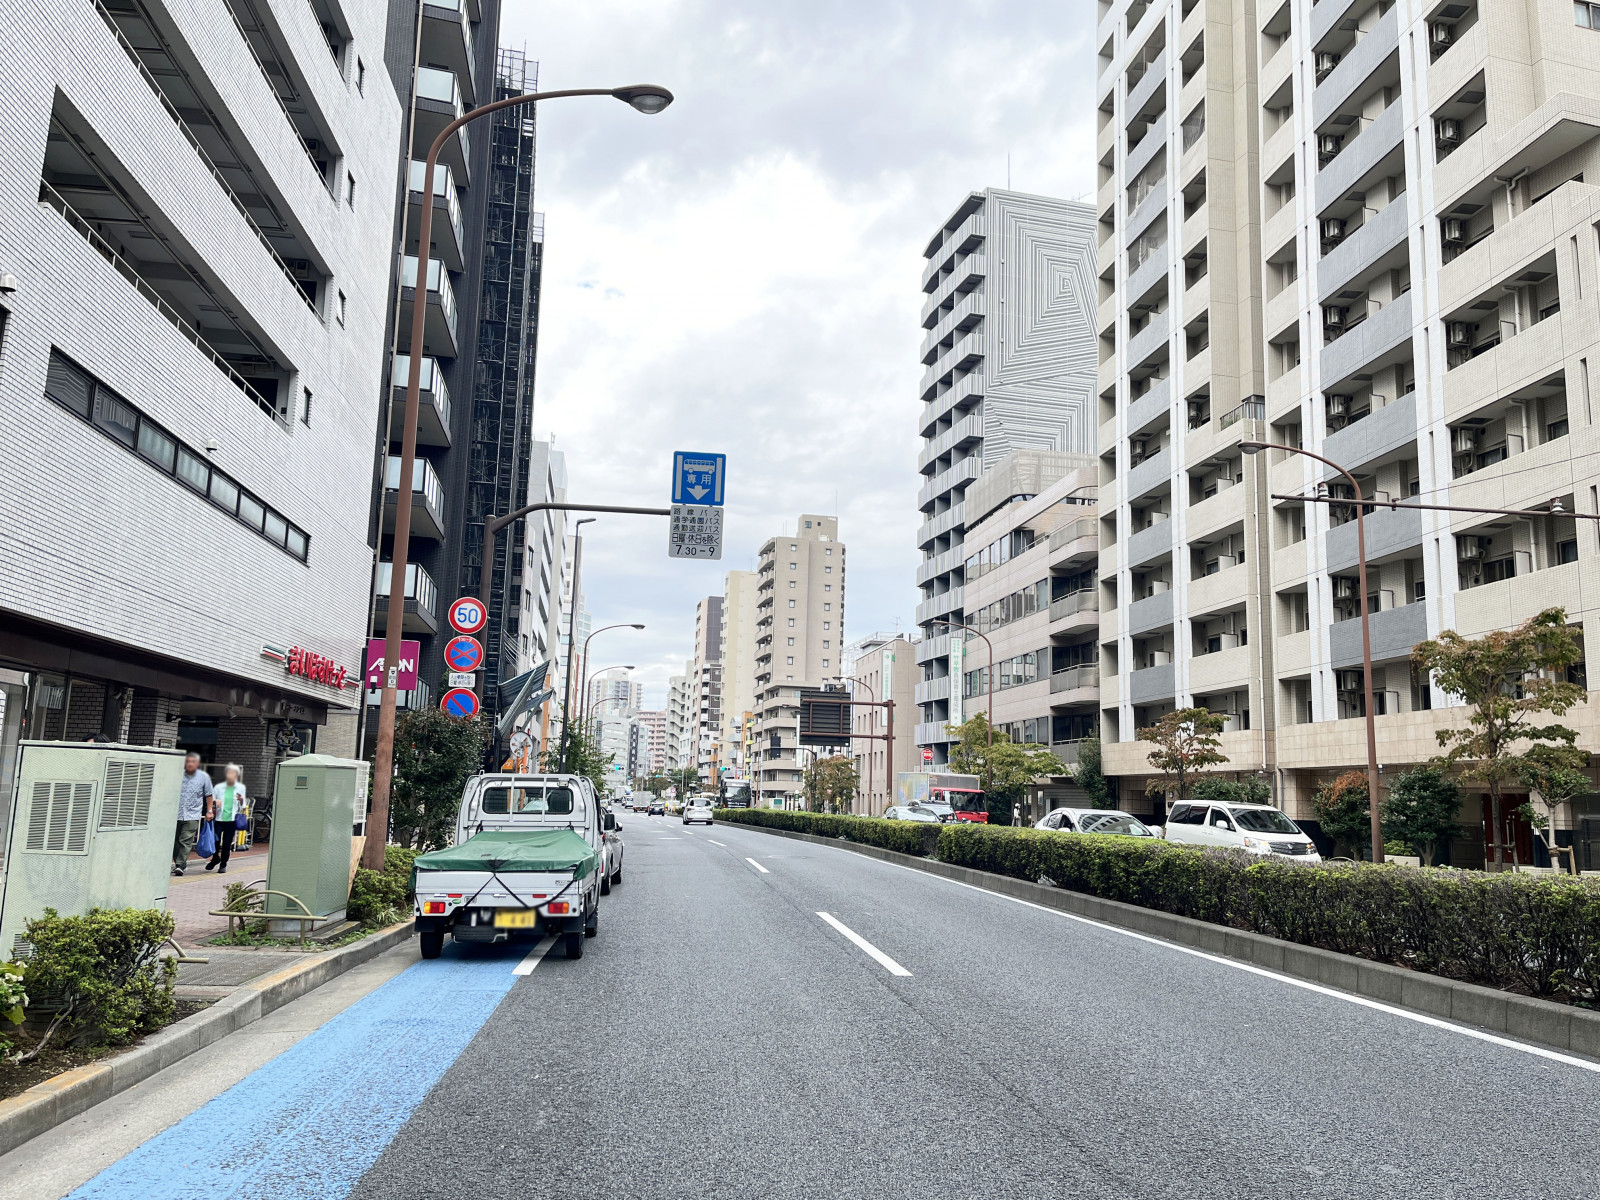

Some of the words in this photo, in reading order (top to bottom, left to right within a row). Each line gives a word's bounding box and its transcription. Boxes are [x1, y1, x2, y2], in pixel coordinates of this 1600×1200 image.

[686, 474, 712, 485] 専用
[673, 507, 721, 518] 路線バス
[457, 607, 478, 624] 50
[288, 645, 347, 690] まいばすけっと
